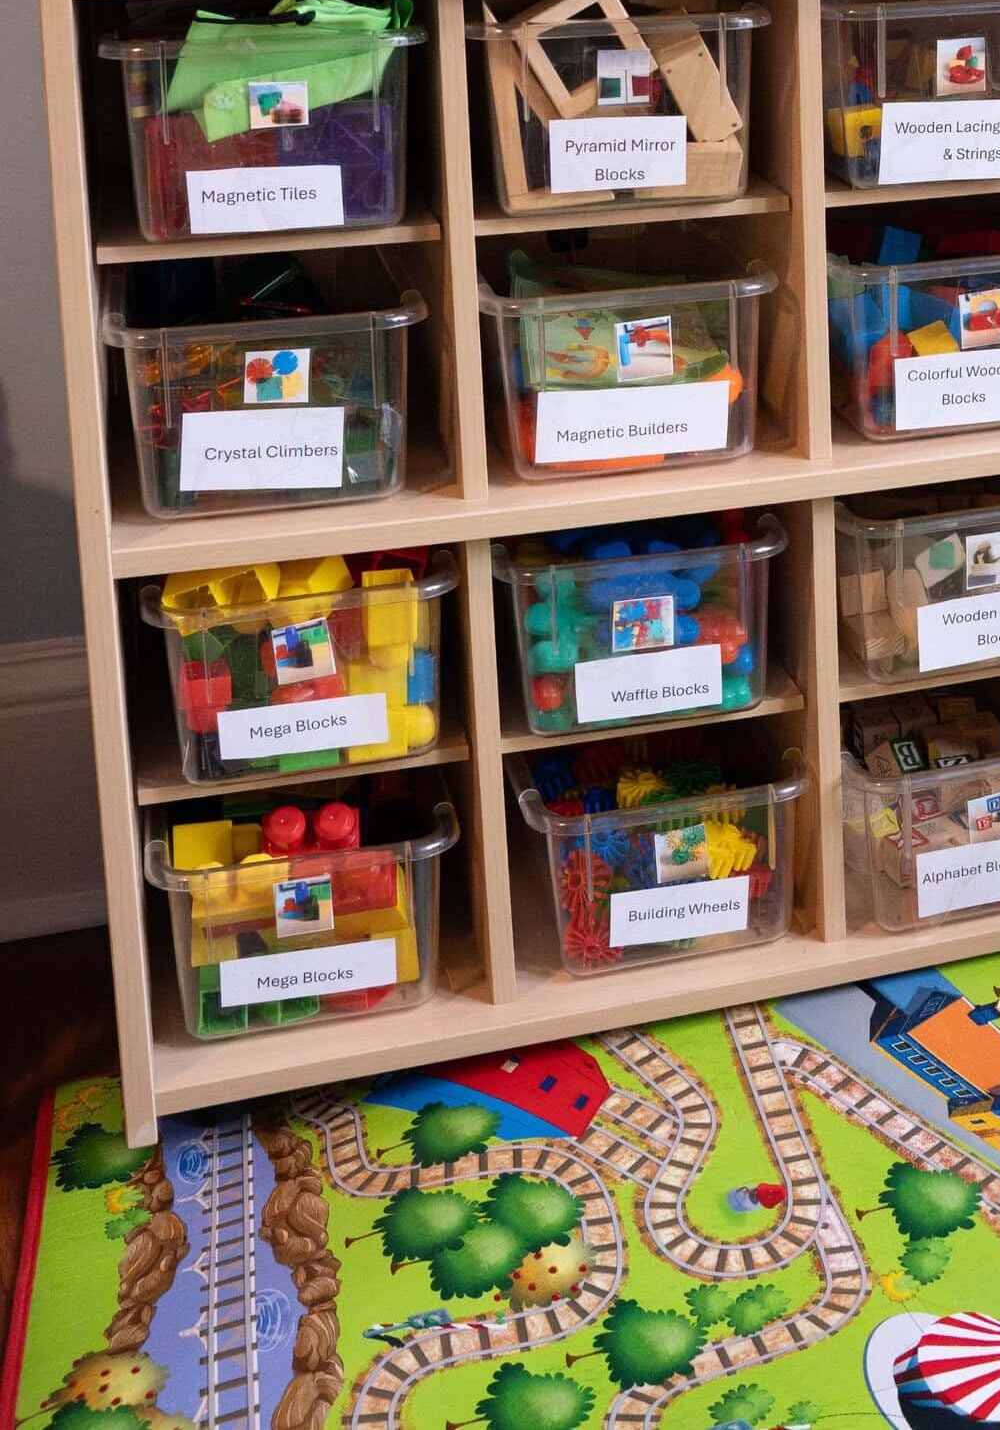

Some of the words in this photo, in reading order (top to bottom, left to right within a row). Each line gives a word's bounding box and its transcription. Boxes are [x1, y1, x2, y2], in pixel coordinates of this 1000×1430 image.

[895, 121, 952, 134] Wooden
[956, 120, 1000, 135] Lacing
[565, 139, 627, 155] Pyramid
[631, 138, 676, 152] Mirror
[943, 148, 953, 160] &
[595, 168, 645, 182] Blocks
[201, 188, 276, 205] Magnetic
[280, 187, 317, 201] Tiles
[907, 367, 963, 382] Colorful
[941, 391, 986, 406] Blocks
[556, 425, 625, 444] Magnetic
[629, 421, 688, 437] Builders
[204, 445, 261, 463] Crystal
[266, 444, 338, 458] Climbers
[942, 608, 998, 626] Wooden
[611, 687, 659, 704] Waffle
[662, 682, 710, 699] Blocks
[250, 723, 292, 740] Mega
[296, 714, 347, 733] Blocks
[922, 864, 983, 885] Alphabet
[628, 905, 686, 922] Building
[688, 899, 741, 915] Wheels
[257, 974, 298, 990] Mega
[302, 969, 354, 984] Blocks
